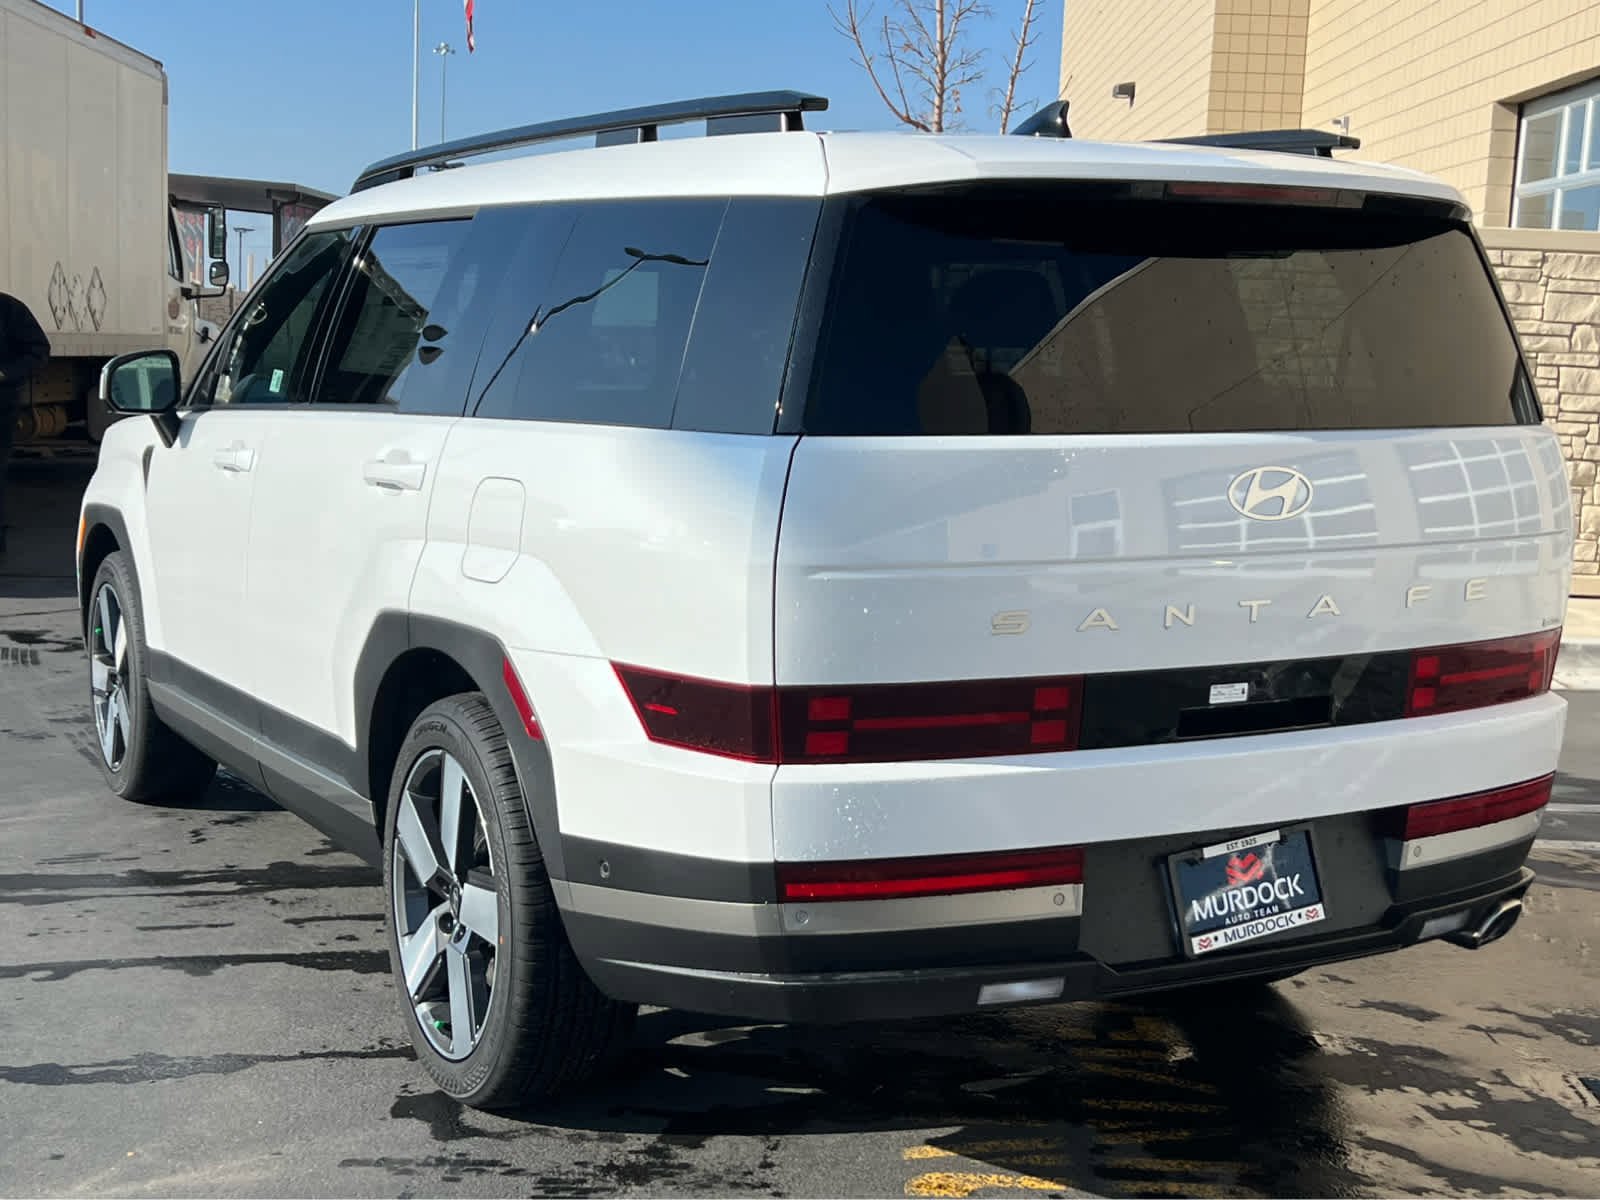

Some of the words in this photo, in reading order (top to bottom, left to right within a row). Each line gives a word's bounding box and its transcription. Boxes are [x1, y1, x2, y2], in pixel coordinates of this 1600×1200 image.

[991, 592, 1342, 635] SANTA
[1406, 577, 1488, 608] FE
[1191, 873, 1304, 922] MURDOCK
[1224, 912, 1251, 926] AUTO
[1254, 904, 1280, 918] TEAM
[1223, 913, 1297, 944] MURDOCK
